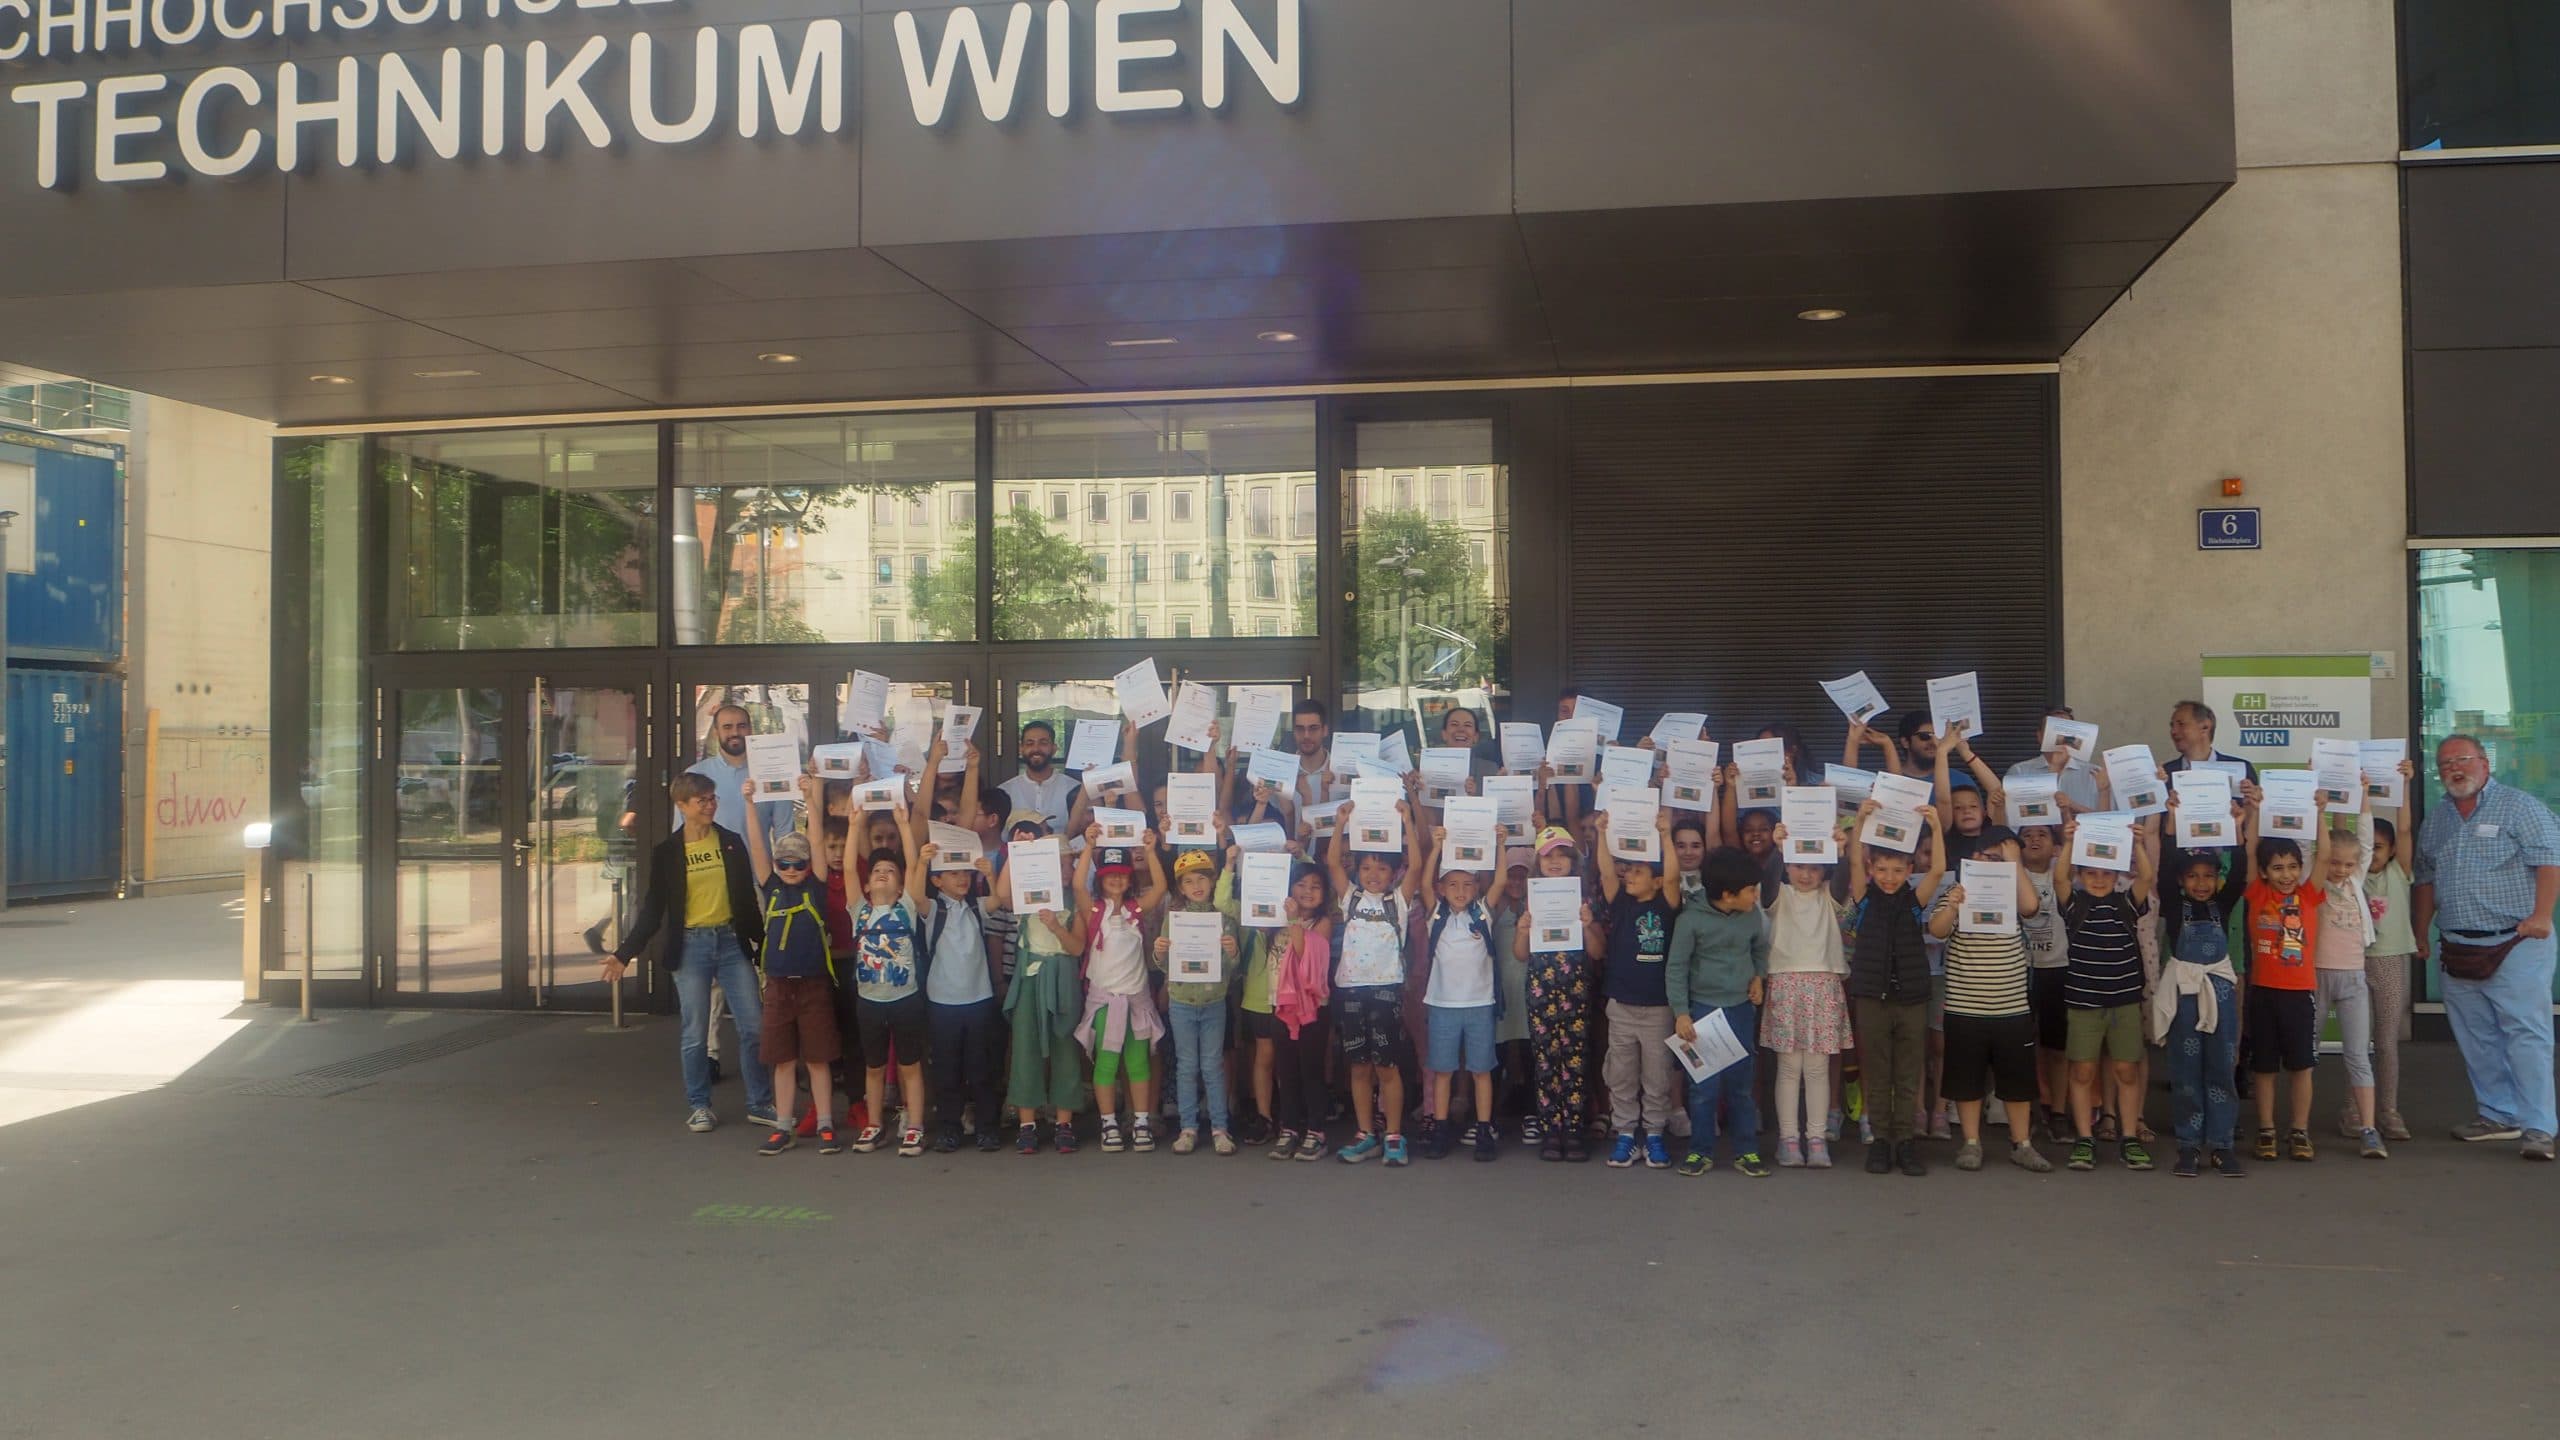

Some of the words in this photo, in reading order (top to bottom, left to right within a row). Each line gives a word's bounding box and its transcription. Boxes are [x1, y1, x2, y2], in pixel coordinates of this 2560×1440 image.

[12, 19, 843, 188] TECHNIKUM
[893, 0, 1300, 126] WIEN
[2222, 514, 2238, 536] 6
[2242, 696, 2261, 707] FH
[2243, 713, 2335, 726] TECHNIKUM
[2244, 732, 2285, 744] WIEN
